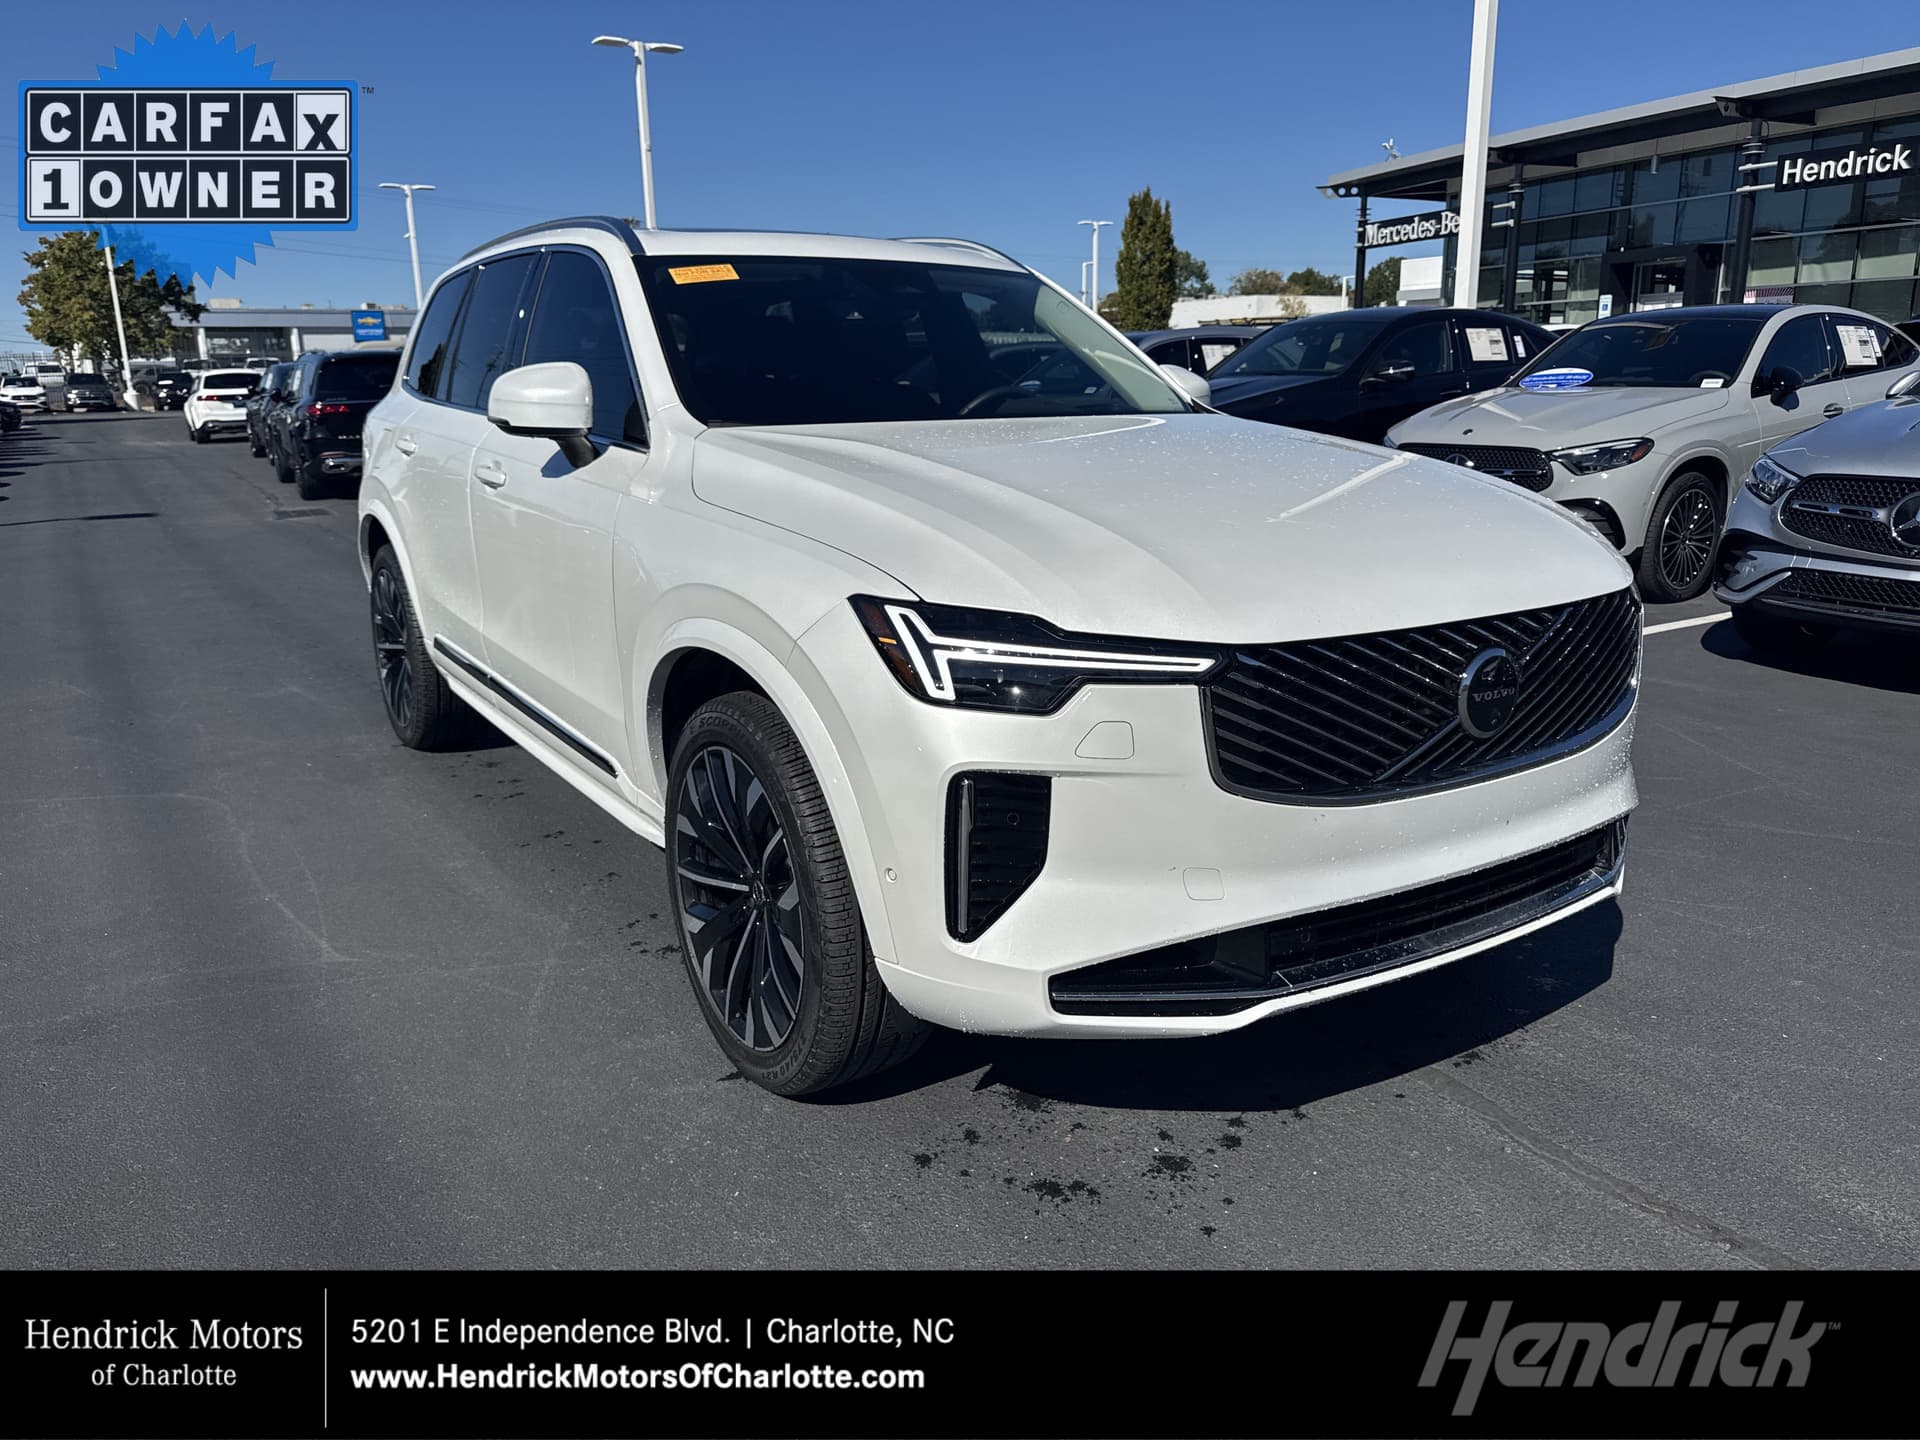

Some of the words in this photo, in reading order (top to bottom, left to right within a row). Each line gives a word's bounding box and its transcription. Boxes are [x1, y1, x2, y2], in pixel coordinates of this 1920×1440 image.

[1782, 144, 1911, 184] Hendrick
[1364, 211, 1461, 246] Mercedes-Be
[1472, 688, 1515, 702] VOLVO
